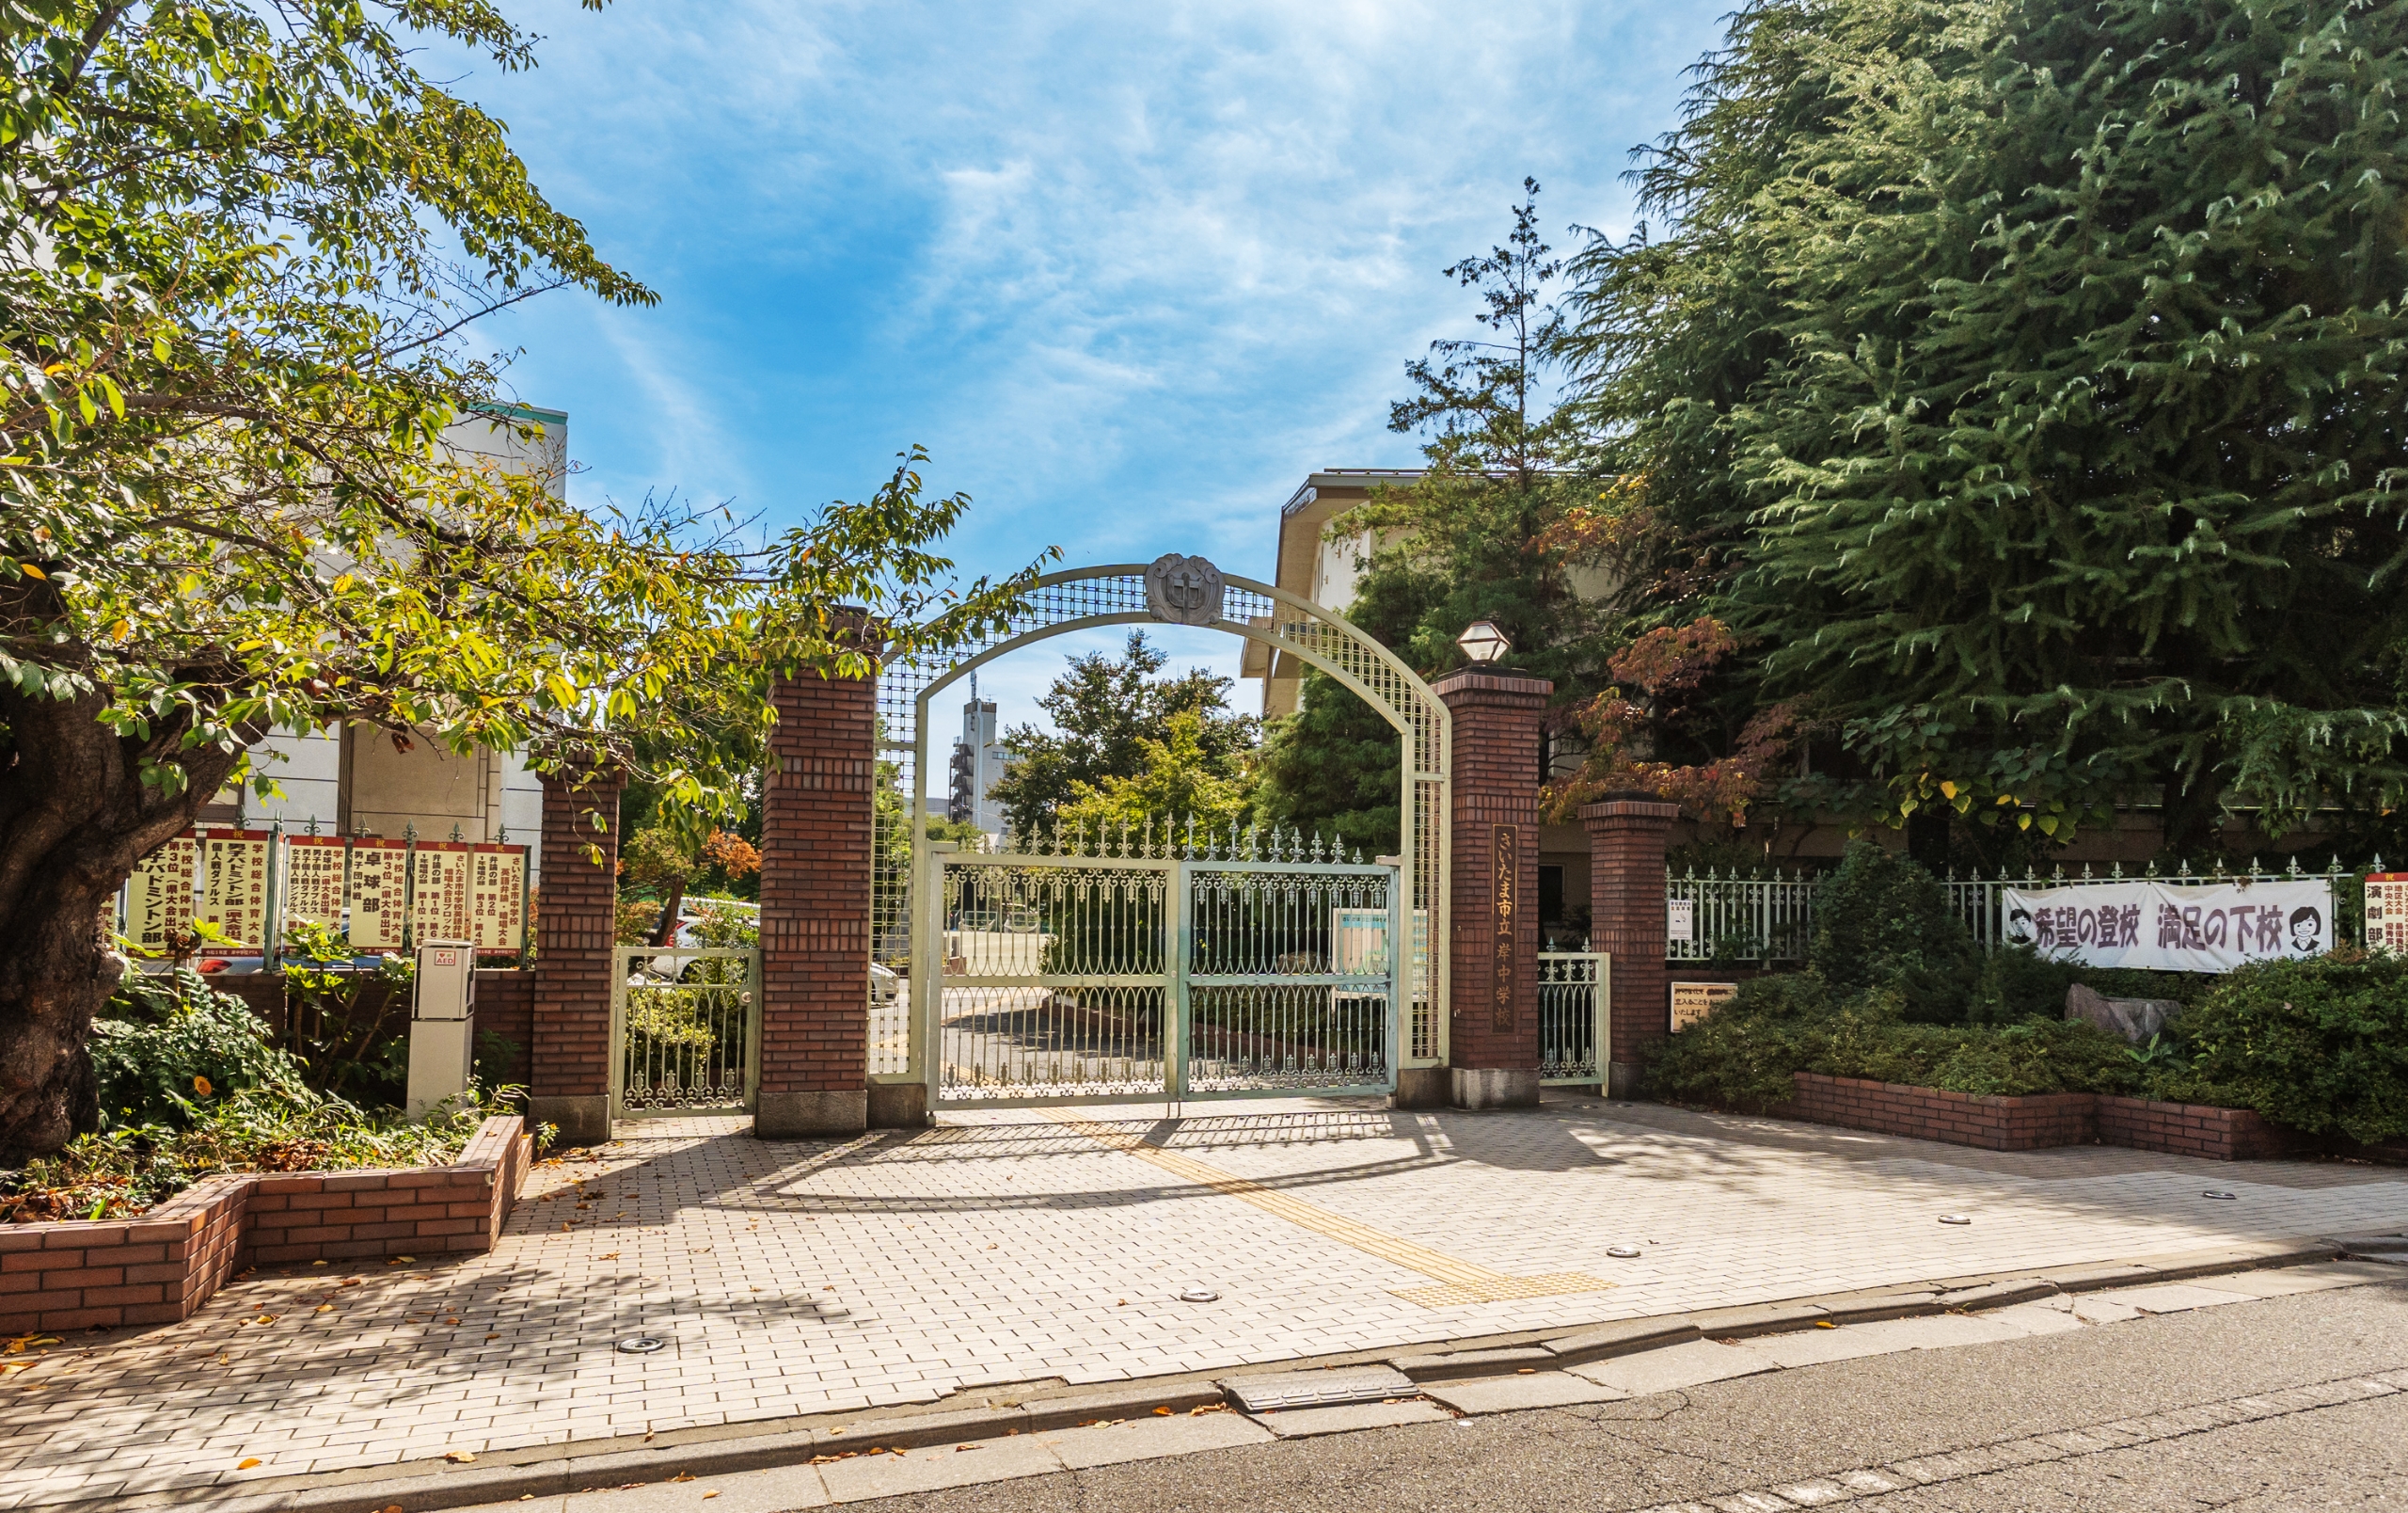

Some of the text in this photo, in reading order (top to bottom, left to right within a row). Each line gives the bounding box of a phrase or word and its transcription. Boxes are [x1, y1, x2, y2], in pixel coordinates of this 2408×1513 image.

[232, 829, 244, 839] 祝
[313, 836, 324, 845] 祝
[375, 838, 386, 848] 祝
[438, 841, 448, 851] 祝
[495, 844, 505, 852] 祝
[209, 842, 223, 906] 個人戦ダブルス
[247, 843, 264, 945] 学校総合体育大会
[289, 848, 300, 915] 女子個人戦シングルス
[300, 849, 311, 914] 男子個人戦ダブルス
[310, 849, 322, 915] 男子個人戦ダブルス
[330, 850, 343, 931] 学校総合体育大
[352, 851, 363, 900] 男子団体戦
[362, 852, 381, 913] 卓球部
[391, 852, 404, 944] 学校総合体育大会
[430, 853, 441, 938] 弁論の部 第1位・第6
[441, 868, 454, 939] 暗唱大会Bブロック大
[487, 855, 499, 916] 弁論の部 第2位
[509, 856, 521, 926] さいたま市中学校
[2384, 872, 2395, 881] 祝
[2384, 884, 2394, 915] 中央大会
[2394, 884, 2403, 916] 地区大会
[498, 868, 511, 946] 英語弁論・暗唱大会
[2035, 903, 2284, 953] 希望の登校 満足の下校
[2367, 884, 2384, 941] 演劇部
